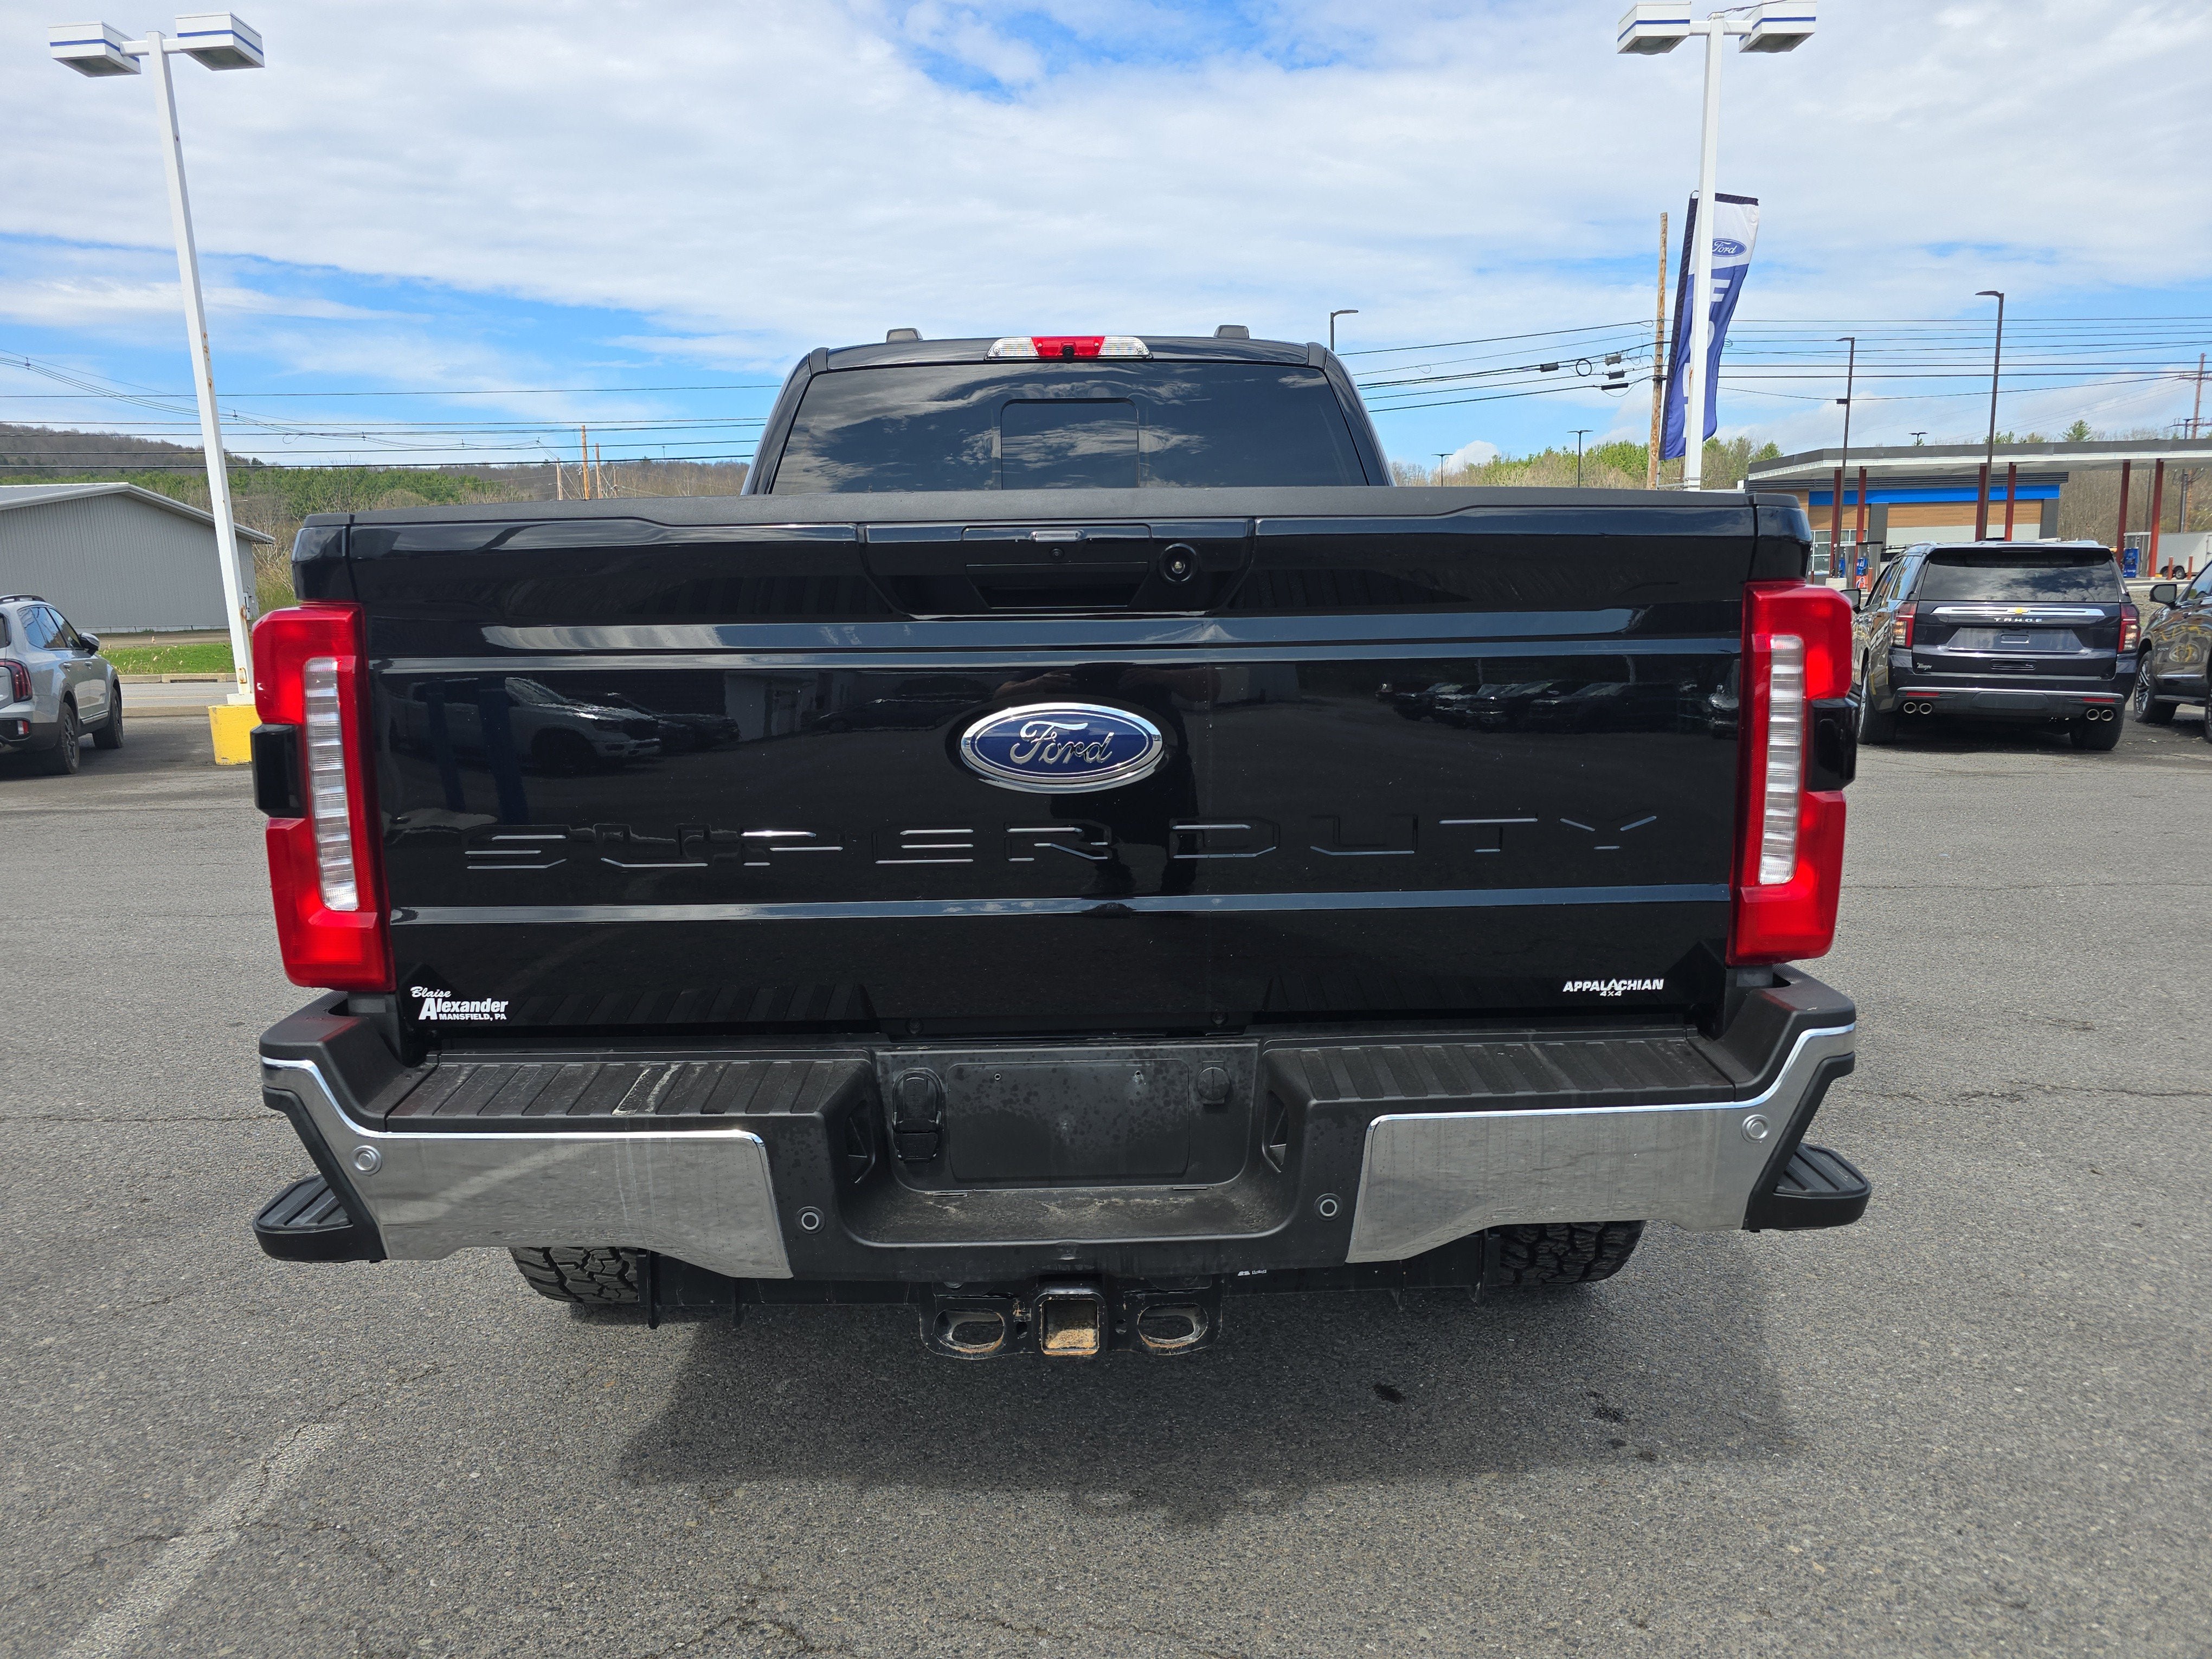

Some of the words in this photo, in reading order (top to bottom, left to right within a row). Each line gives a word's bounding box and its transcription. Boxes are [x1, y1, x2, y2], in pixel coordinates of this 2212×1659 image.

[1712, 241, 1738, 254] Ford
[1009, 721, 1115, 765] Ford
[410, 986, 452, 998] Blaise
[1562, 978, 1664, 992] APPALACHIAN
[418, 998, 509, 1020] Alexander
